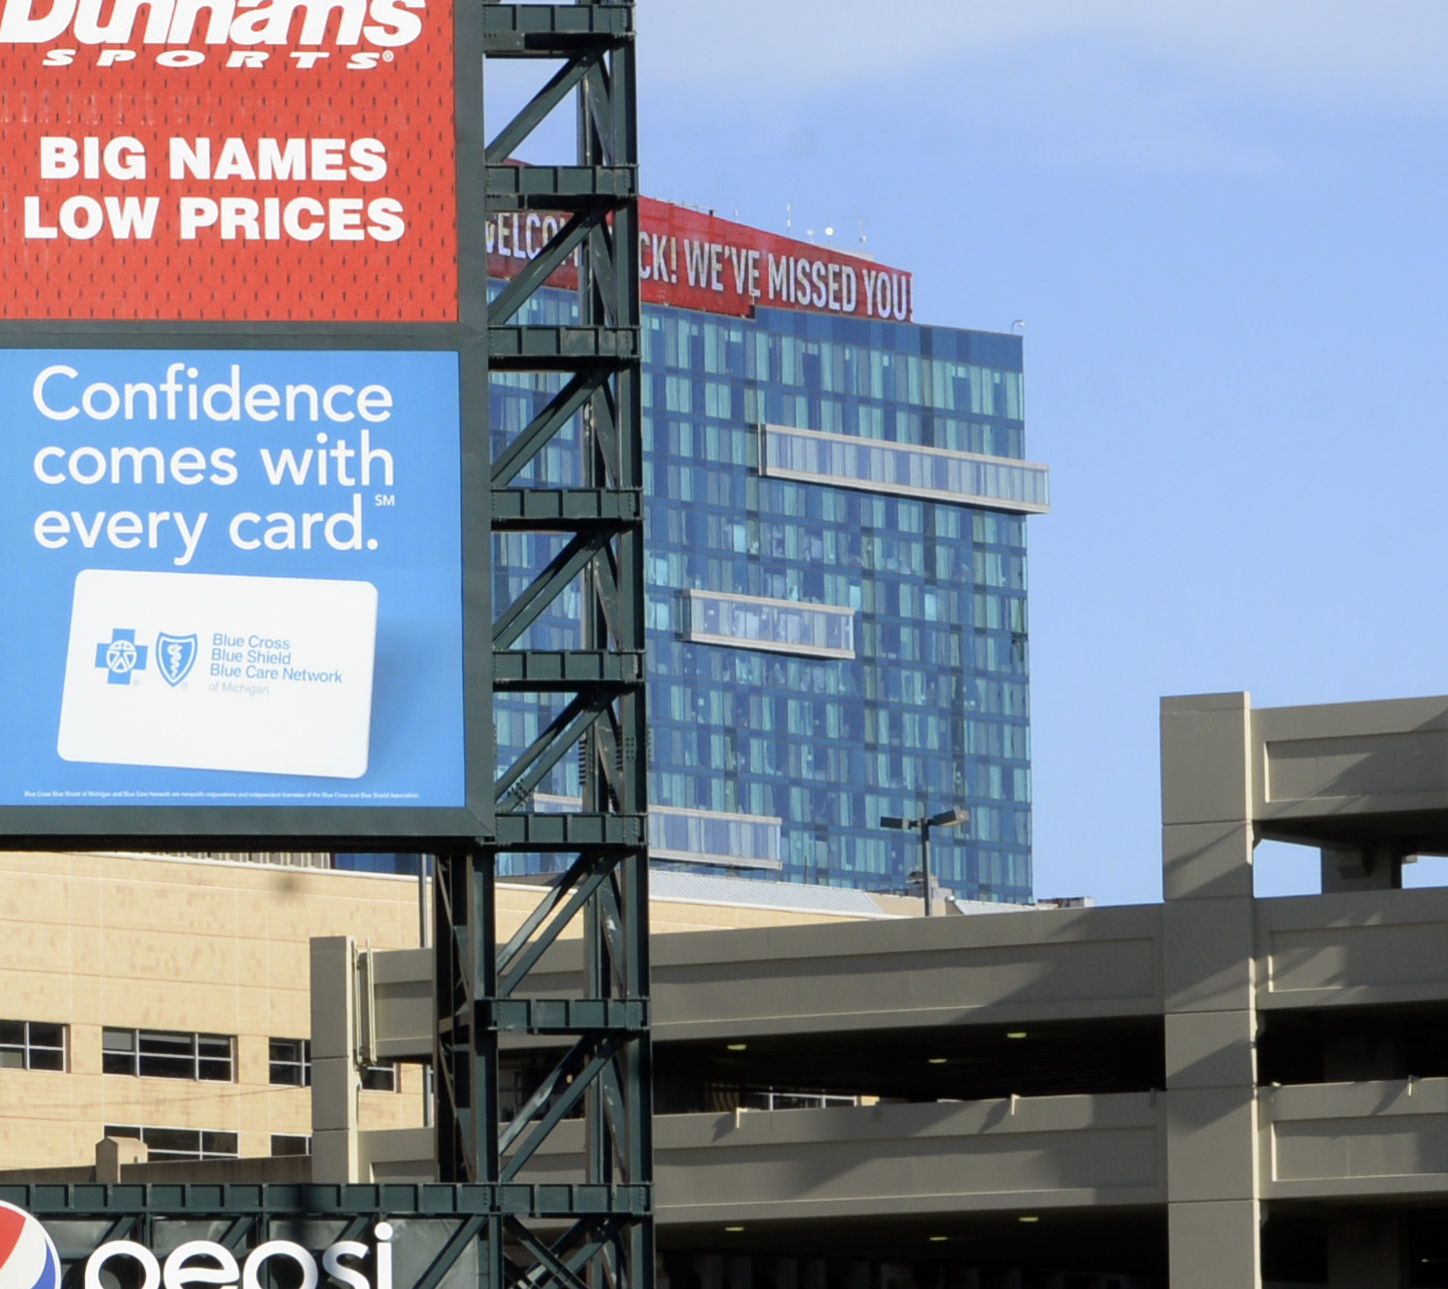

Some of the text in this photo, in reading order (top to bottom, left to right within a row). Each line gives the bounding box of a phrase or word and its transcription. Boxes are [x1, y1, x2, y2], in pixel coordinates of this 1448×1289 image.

[43, 48, 381, 69] SPORTS
[39, 137, 387, 182] BIG NAMES
[24, 197, 405, 242] LOW PRICES
[485, 212, 579, 267] WELCO
[684, 239, 761, 299] WE'VE
[767, 252, 857, 313] MISSED
[32, 362, 393, 423] Confidence
[33, 429, 395, 486] comes with
[33, 493, 379, 566] every card.
[211, 648, 292, 666] Blue Shield
[212, 633, 291, 650] Blue Cross
[209, 681, 270, 697] of Michigan
[210, 663, 343, 685] Blue Care Network
